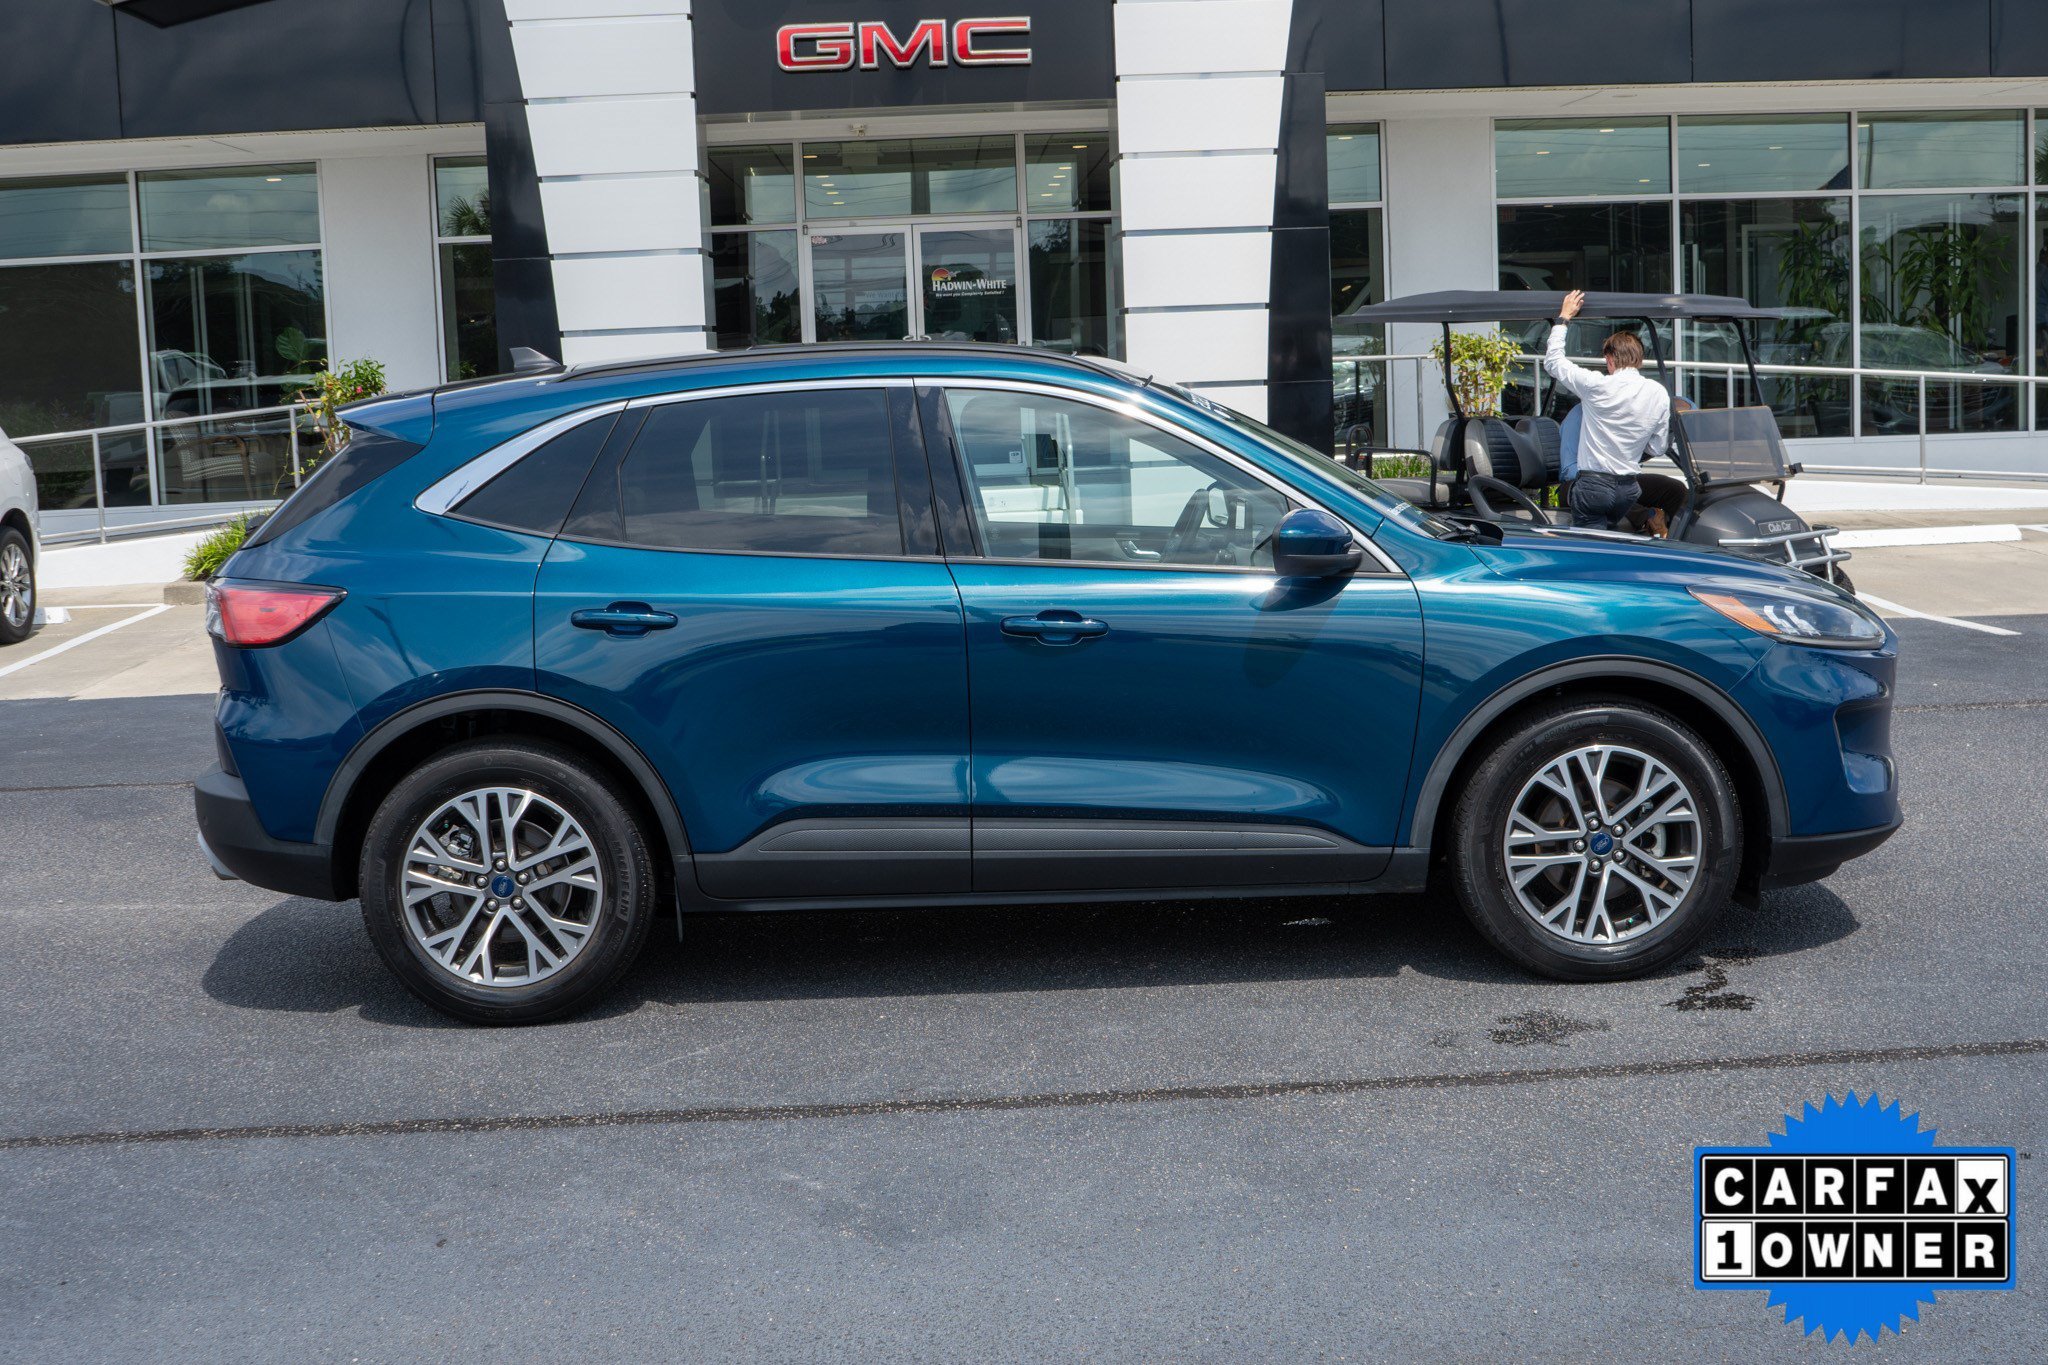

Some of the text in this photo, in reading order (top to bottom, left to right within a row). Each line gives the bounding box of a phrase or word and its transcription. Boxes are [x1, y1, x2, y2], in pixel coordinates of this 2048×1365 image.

[776, 16, 1032, 73] GMC
[1768, 521, 1792, 533] Club Car
